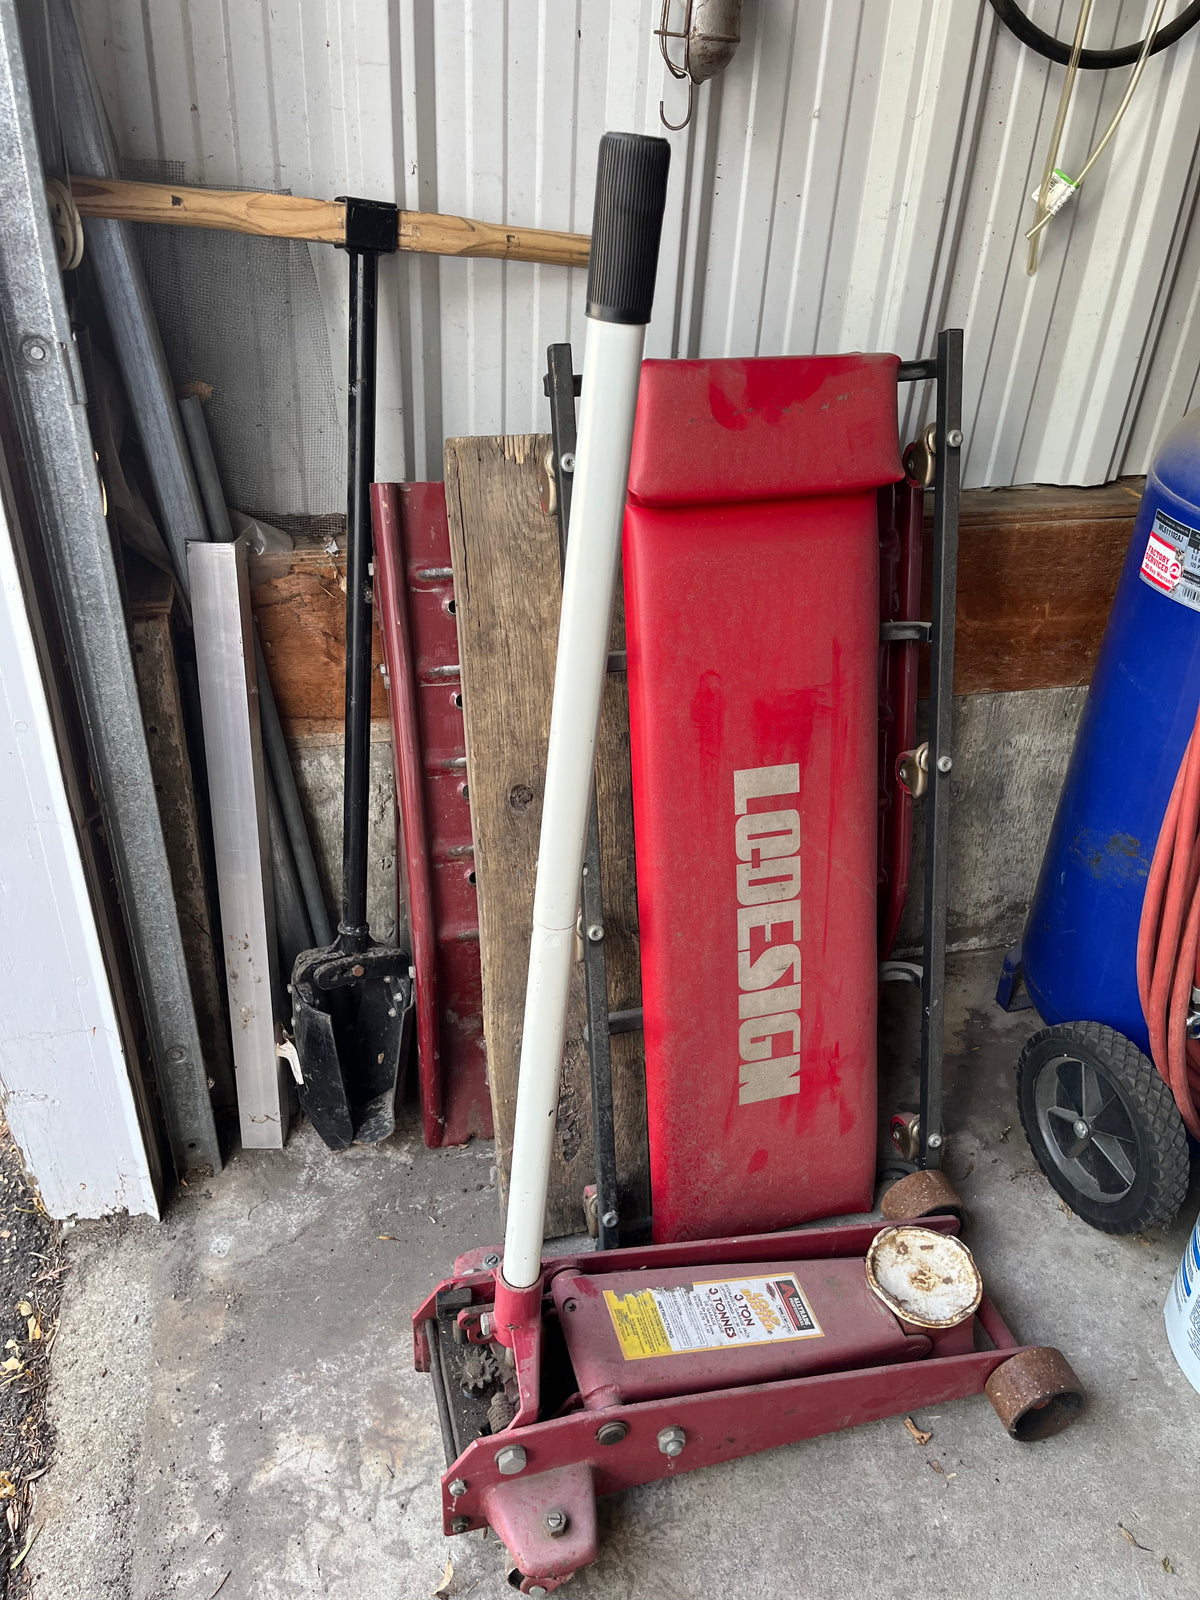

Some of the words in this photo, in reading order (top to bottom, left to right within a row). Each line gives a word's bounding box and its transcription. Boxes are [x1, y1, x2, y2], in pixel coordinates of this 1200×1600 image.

[1145, 552, 1169, 574] SERVICED
[1147, 544, 1170, 565] FACTORY
[1156, 571, 1175, 588] Warranty
[707, 1287, 719, 1295] 3
[732, 1293, 745, 1302] 3
[656, 1300, 674, 1339] INSTRUCTIONS
[711, 1296, 737, 1338] TONNES
[736, 1303, 756, 1326] TON
[739, 1288, 775, 1330] BUSTER
[752, 1292, 782, 1326] LOAD
